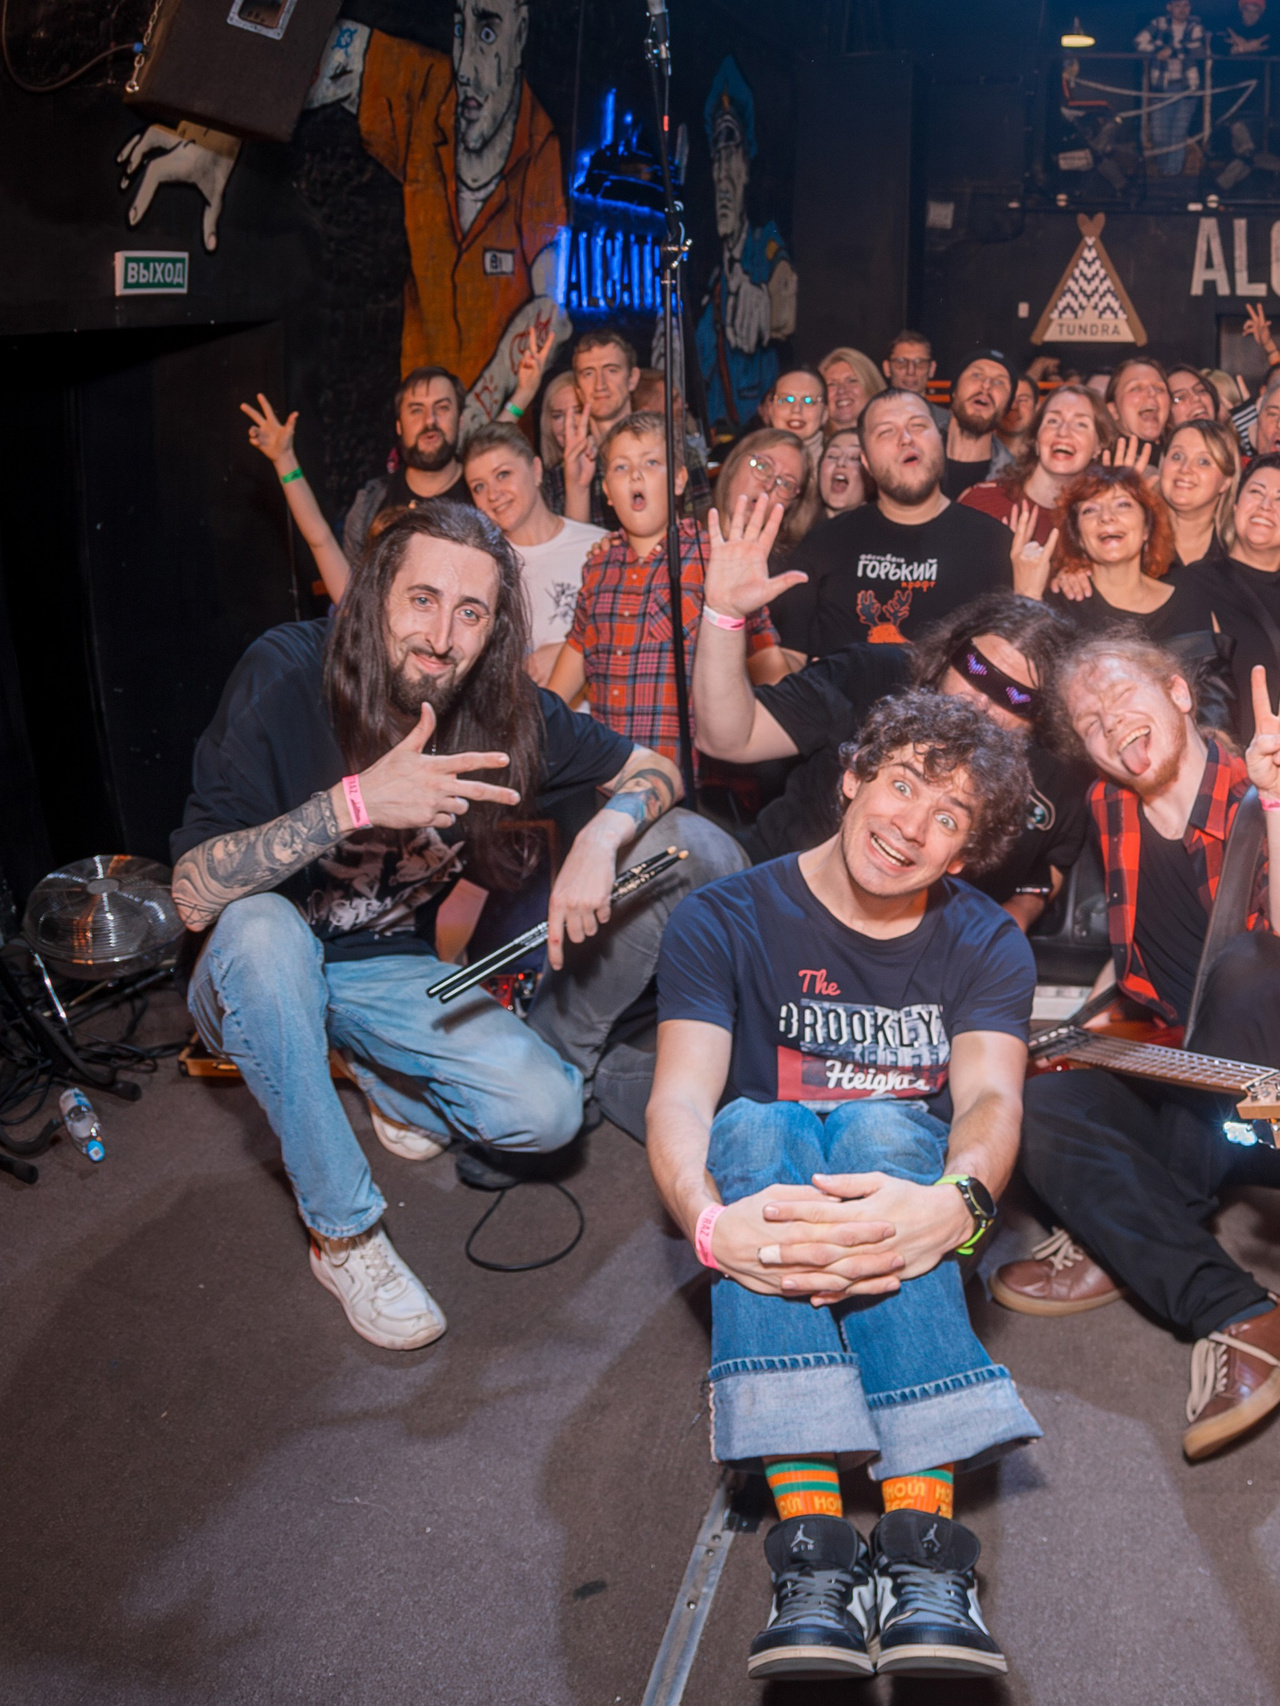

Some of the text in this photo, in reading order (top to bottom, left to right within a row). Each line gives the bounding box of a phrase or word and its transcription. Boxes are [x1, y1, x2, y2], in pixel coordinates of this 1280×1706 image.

[127, 262, 184, 285] ВЫХОД
[1056, 323, 1121, 336] TUNDRA
[857, 558, 938, 581] ГОРЬКИЙ
[798, 968, 841, 996] The
[777, 1002, 943, 1048] BROOKLY
